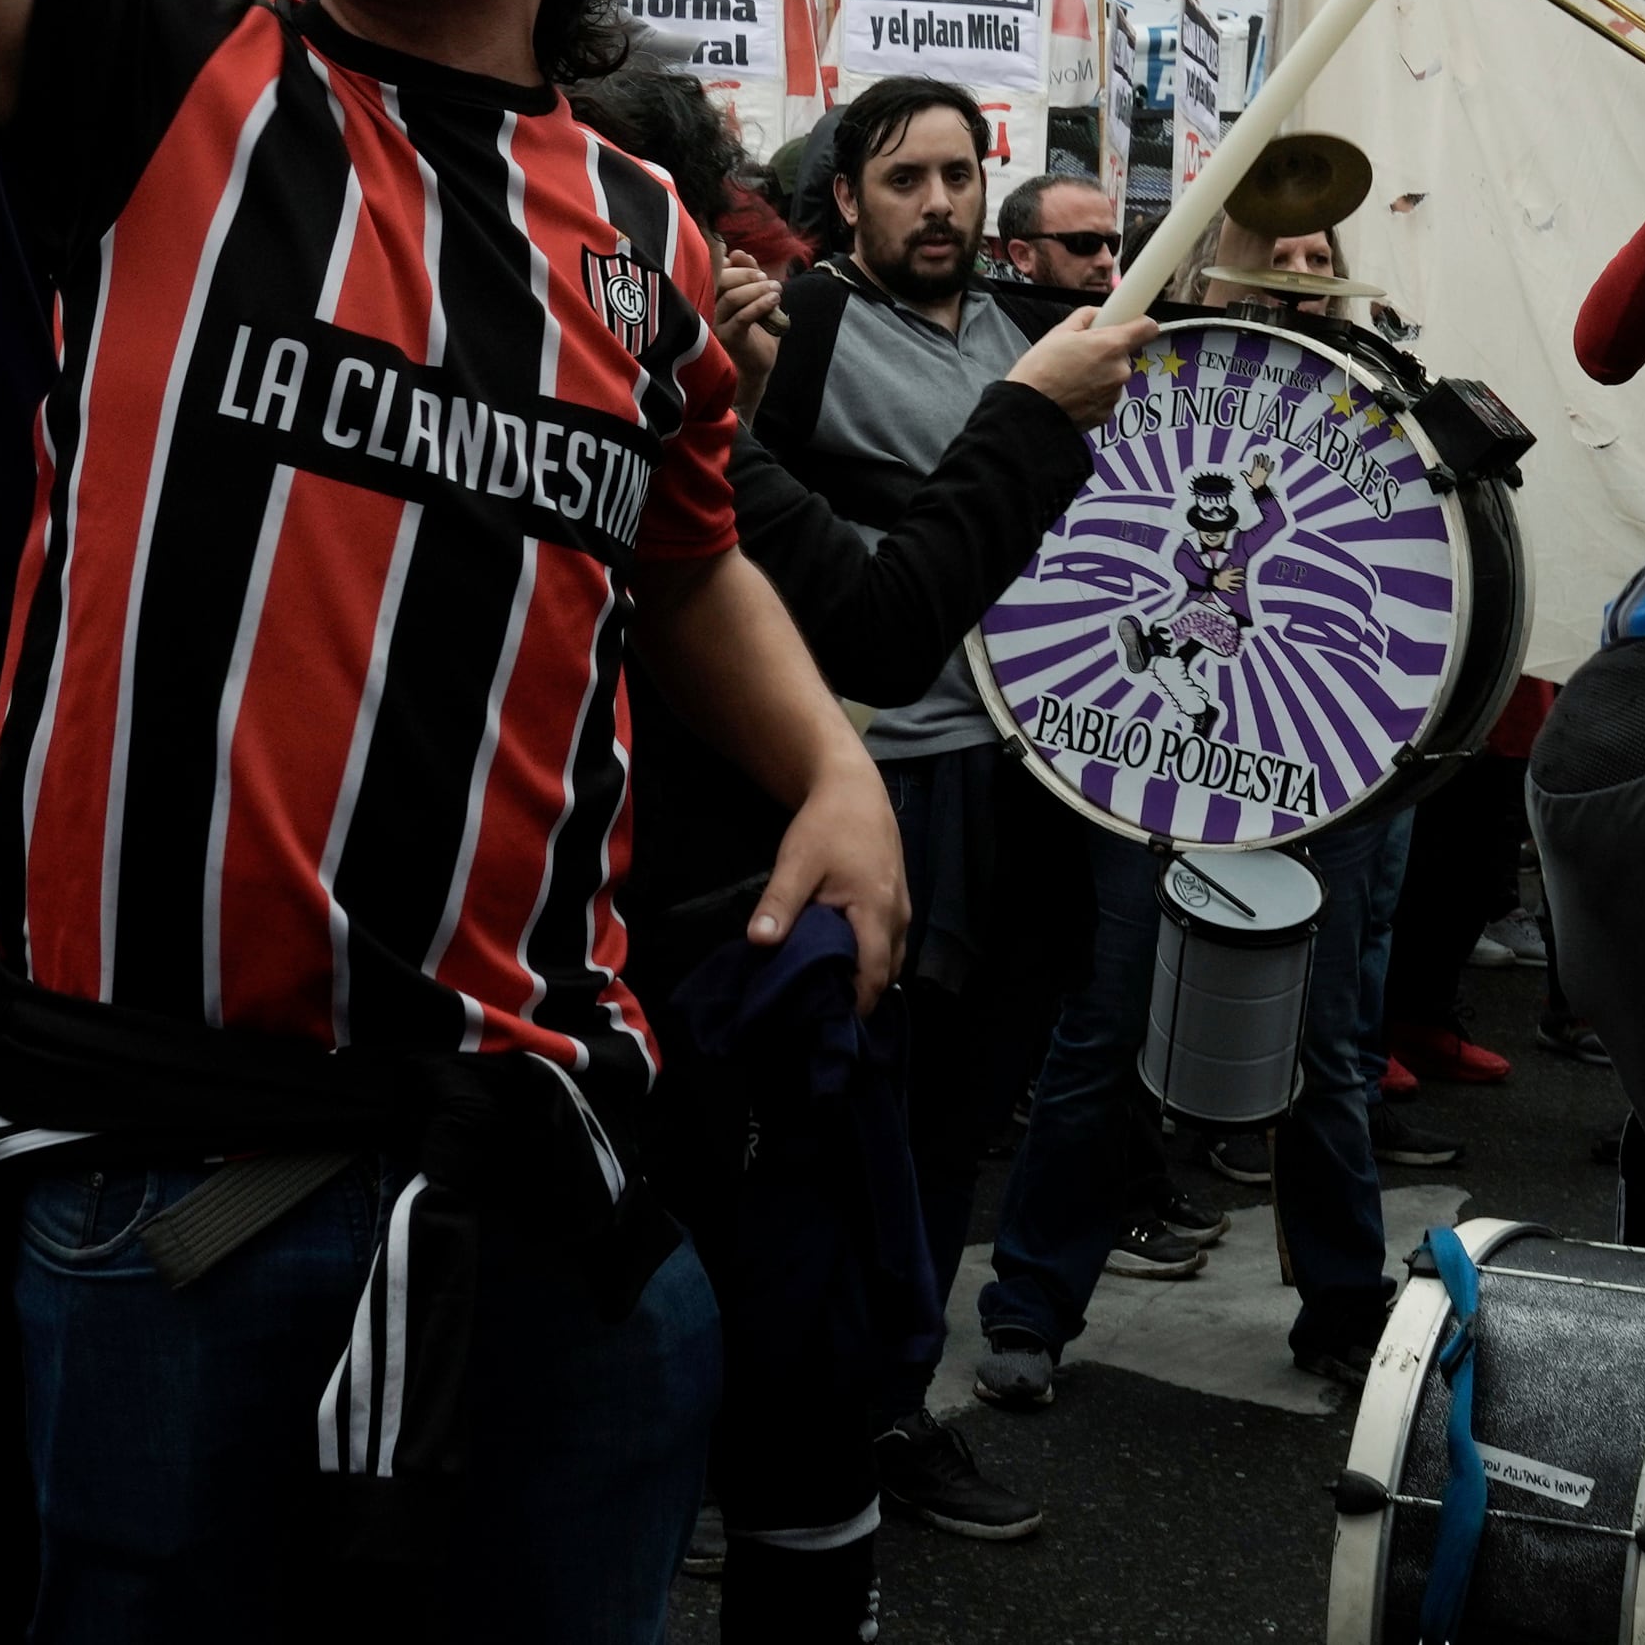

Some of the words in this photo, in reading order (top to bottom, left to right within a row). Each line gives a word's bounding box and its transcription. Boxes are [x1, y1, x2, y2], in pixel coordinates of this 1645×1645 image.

[871, 15, 884, 51] y
[888, 9, 909, 45] el
[913, 10, 964, 53] plan
[967, 13, 1020, 52] Milei
[1195, 349, 1261, 378] CENTRO
[1263, 367, 1323, 394] MURGA
[218, 324, 308, 431] LA
[323, 357, 652, 549] CLANDESTIN
[1100, 389, 1162, 450] LOS
[1171, 386, 1402, 522] INIGUALABLES
[1034, 696, 1152, 770] PABLO
[1152, 728, 1320, 818] PODESTA
